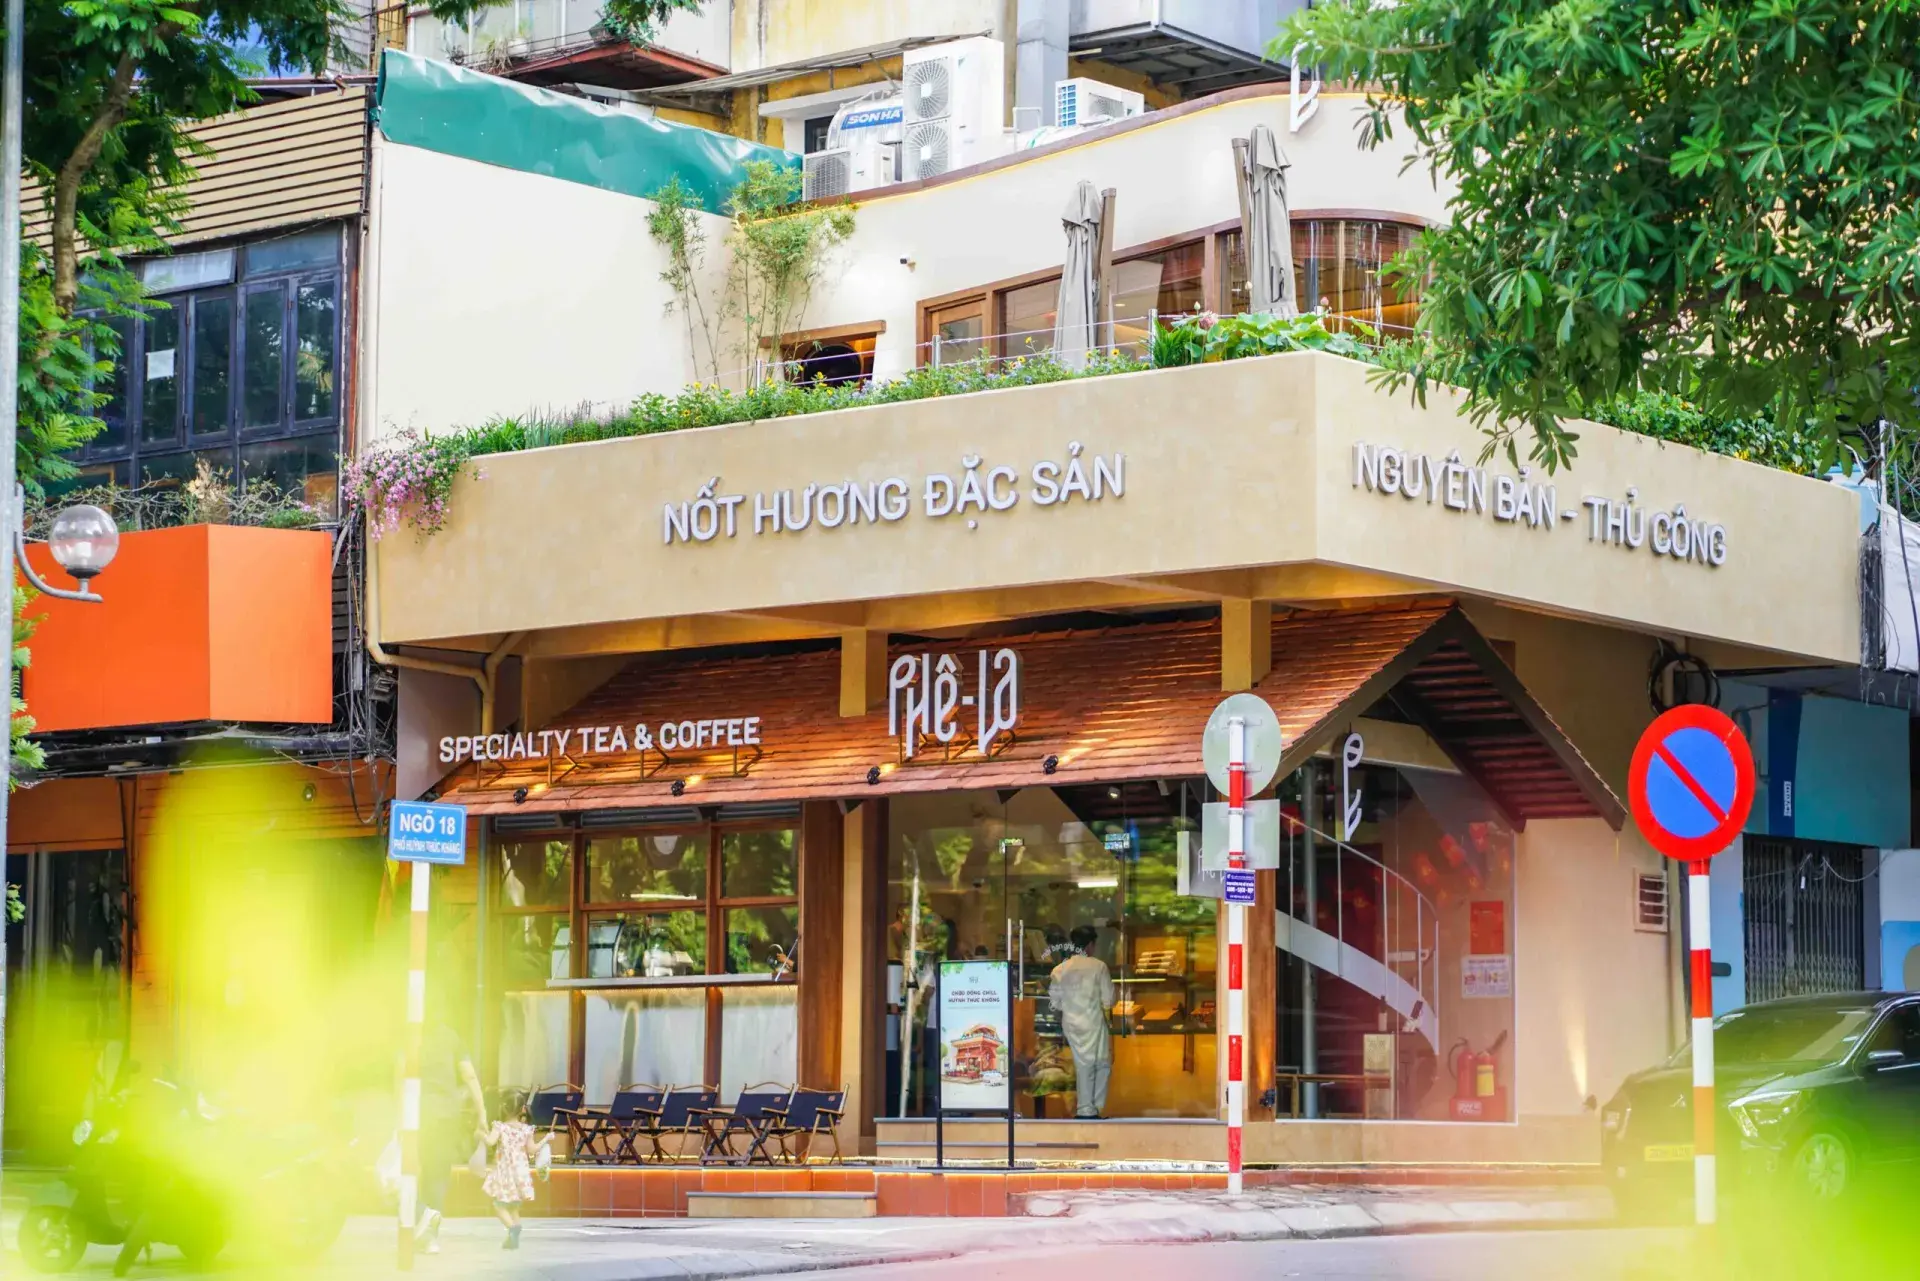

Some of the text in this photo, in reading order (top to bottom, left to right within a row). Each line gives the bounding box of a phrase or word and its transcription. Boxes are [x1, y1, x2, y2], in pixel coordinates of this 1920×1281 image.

[664, 441, 1126, 544] NỐT HƯƠNG ĐẶC SẢN
[1352, 441, 1487, 514] NGUYÊN
[1493, 465, 1556, 531] BẢN
[1582, 485, 1645, 549] THỦ
[1651, 503, 1726, 567] CÔNG
[439, 716, 761, 763] SPECIALTY TEA & COFFEE
[399, 809, 456, 836] NGÕ 18
